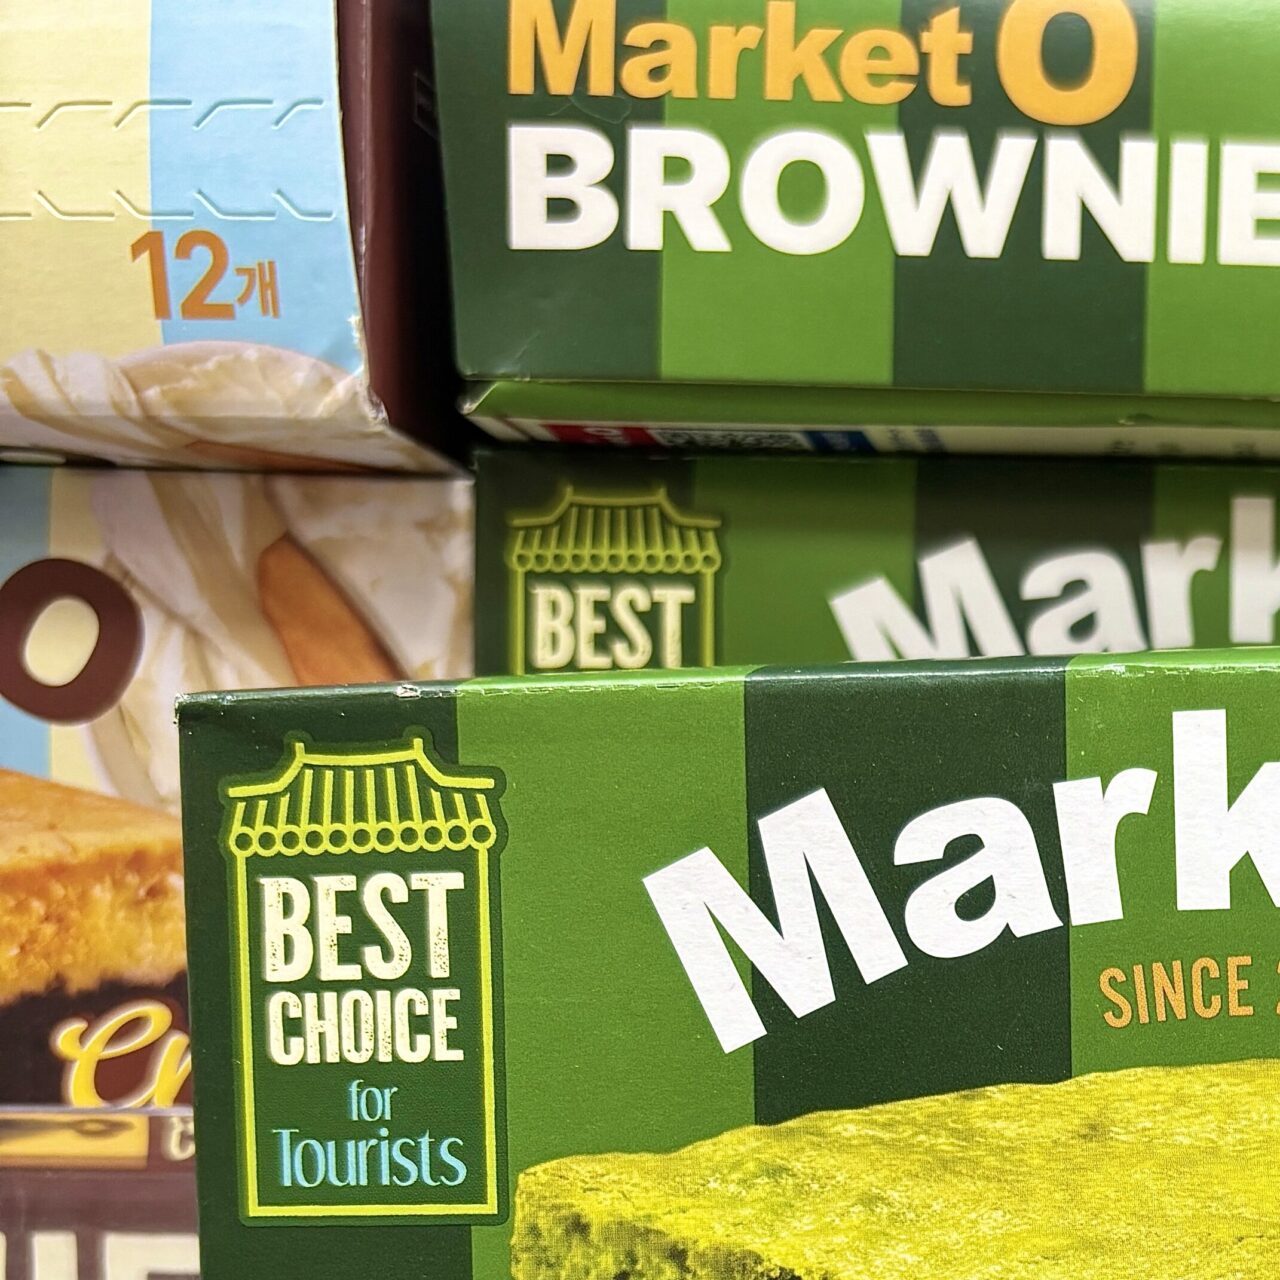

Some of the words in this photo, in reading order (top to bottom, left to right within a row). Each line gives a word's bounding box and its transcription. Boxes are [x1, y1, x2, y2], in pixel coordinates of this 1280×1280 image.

[508, 0, 973, 105] Market
[998, 0, 1138, 125] O
[130, 230, 281, 321] 12개
[531, 582, 695, 669] BEST
[257, 872, 465, 983] BEST
[266, 988, 465, 1067] CHOICE
[1099, 956, 1253, 1029] SINCE
[348, 1079, 398, 1122] for
[272, 1128, 467, 1188] Tourists
